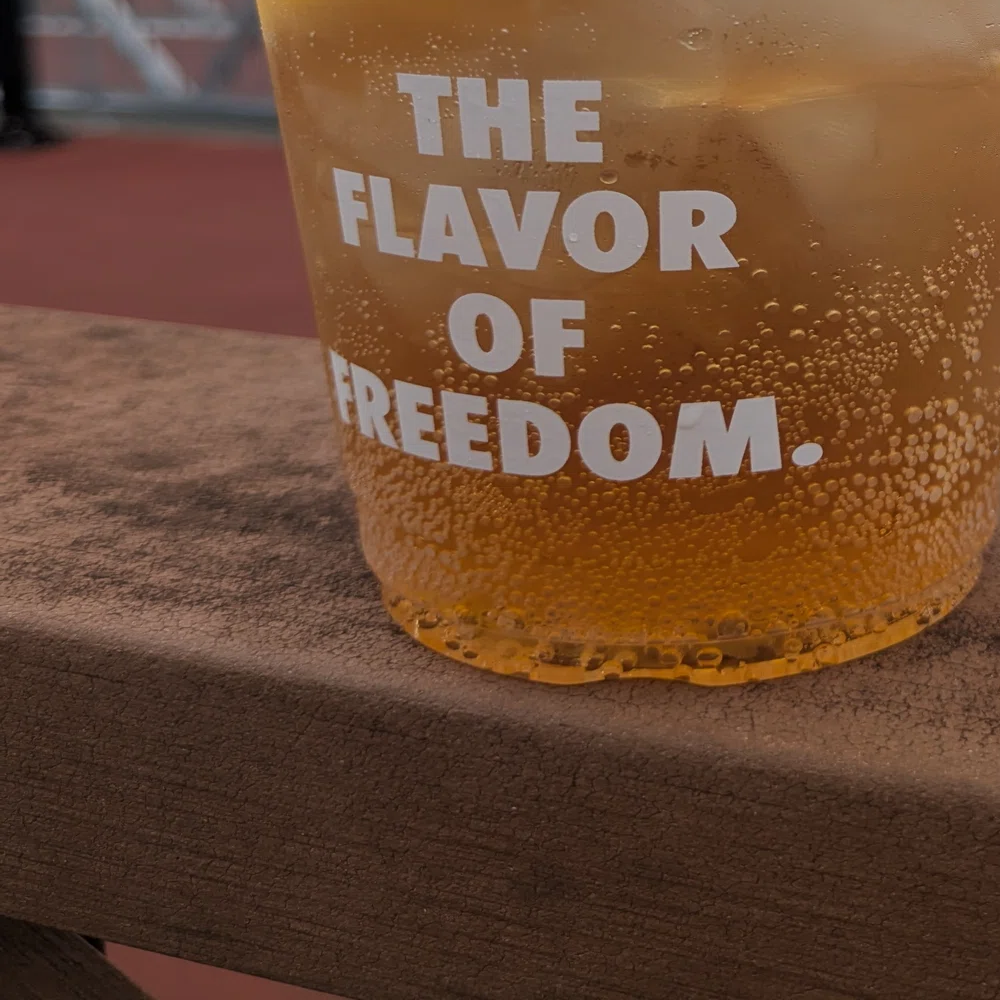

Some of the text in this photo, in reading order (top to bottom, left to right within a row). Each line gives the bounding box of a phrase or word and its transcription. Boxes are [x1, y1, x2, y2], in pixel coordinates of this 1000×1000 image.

[396, 73, 603, 163] THE
[332, 167, 740, 273] FLAVOR
[448, 292, 586, 378] OF
[329, 348, 823, 482] FREEDOM.
